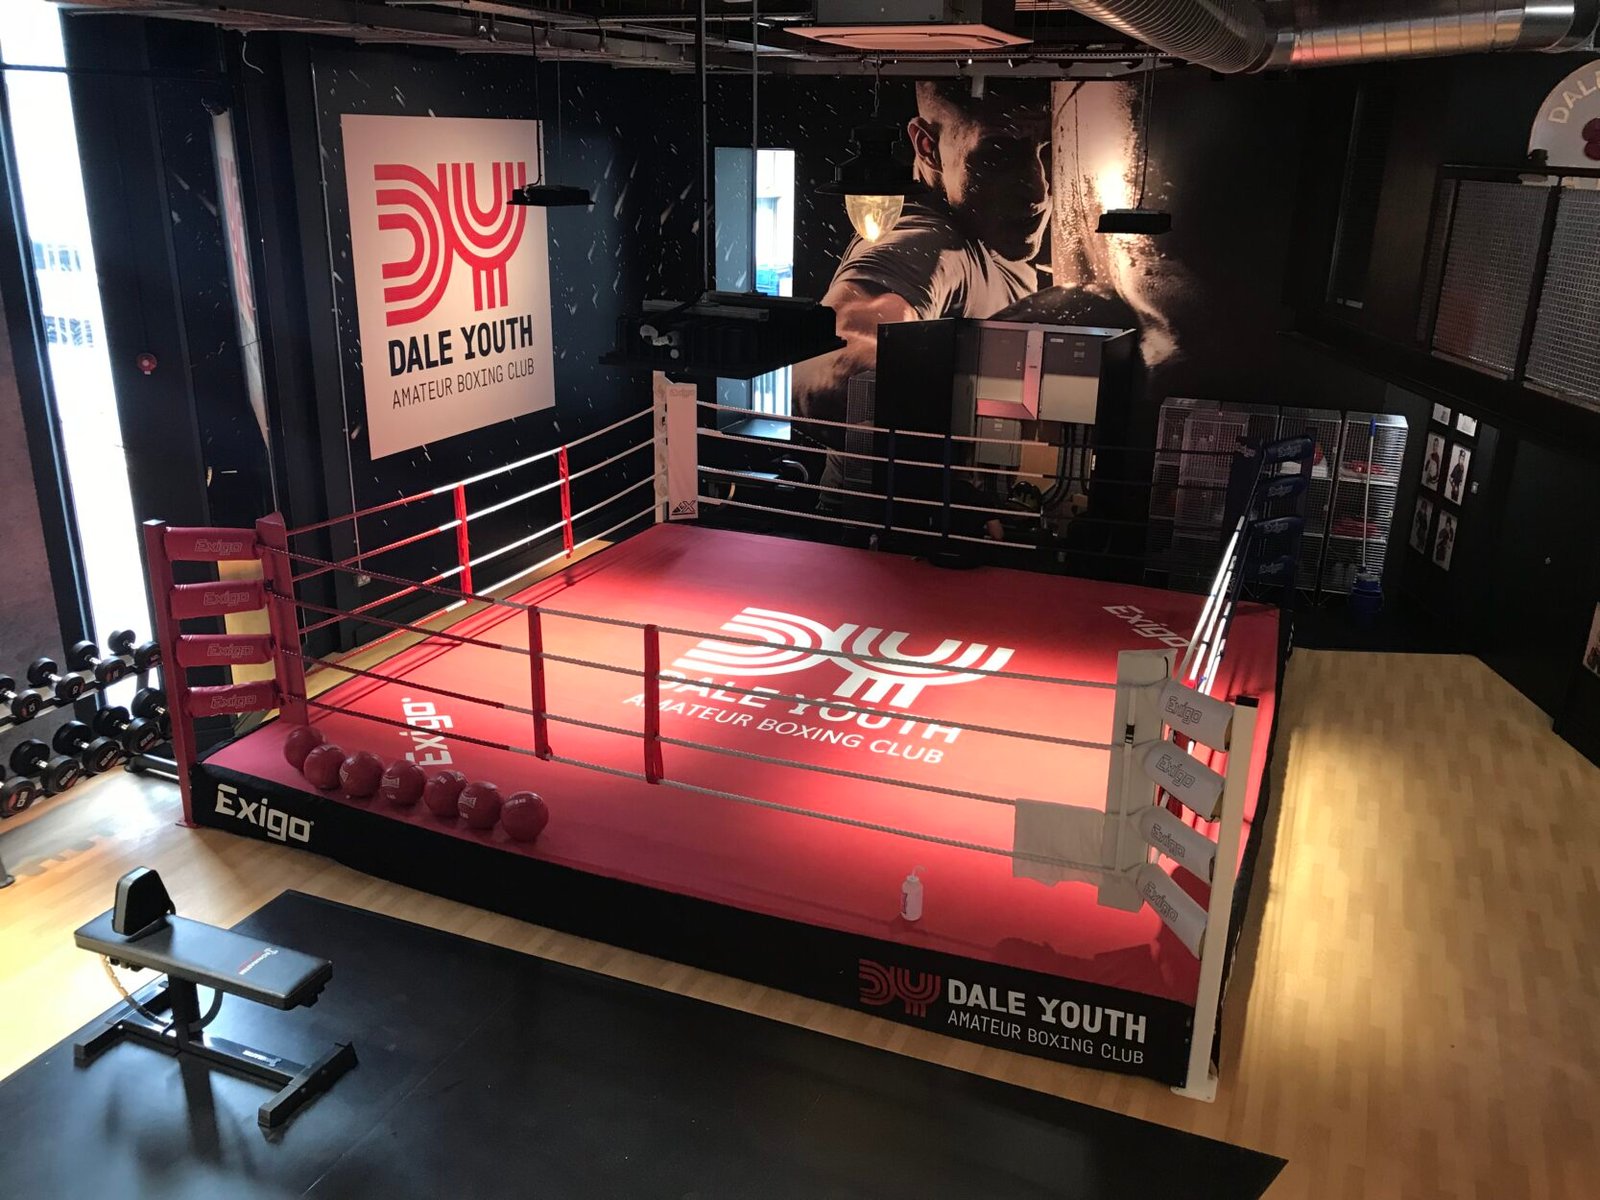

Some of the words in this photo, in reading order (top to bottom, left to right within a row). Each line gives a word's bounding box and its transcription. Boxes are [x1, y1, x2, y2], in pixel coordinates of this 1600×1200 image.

[388, 330, 452, 377] DALE
[460, 314, 534, 360] YOUTH
[392, 377, 453, 410] AMATEUR
[456, 371, 504, 393] BOXING
[507, 358, 535, 377] CLUB
[194, 539, 243, 556] Exigo
[203, 591, 250, 607] Exigo
[1102, 605, 1189, 648] Exigo
[207, 643, 254, 658] Exigo
[210, 693, 257, 709] Exigo
[787, 694, 962, 744] YOUTH
[1165, 695, 1202, 725] Exigo
[399, 697, 454, 766] Exigo
[622, 693, 751, 726] AMATEUR
[756, 718, 863, 749] BOXING
[868, 738, 945, 765] CLUB
[1155, 753, 1196, 789] Exigo
[214, 783, 314, 843] Exigo
[1150, 823, 1186, 858] Exigo
[1143, 882, 1179, 923] Exigo
[948, 978, 1027, 1017] DALE
[1037, 995, 1147, 1044] YOUTH
[947, 1009, 1022, 1040] AMATEUR
[1027, 1027, 1094, 1055] BOXING
[1100, 1043, 1145, 1065] CLUB
